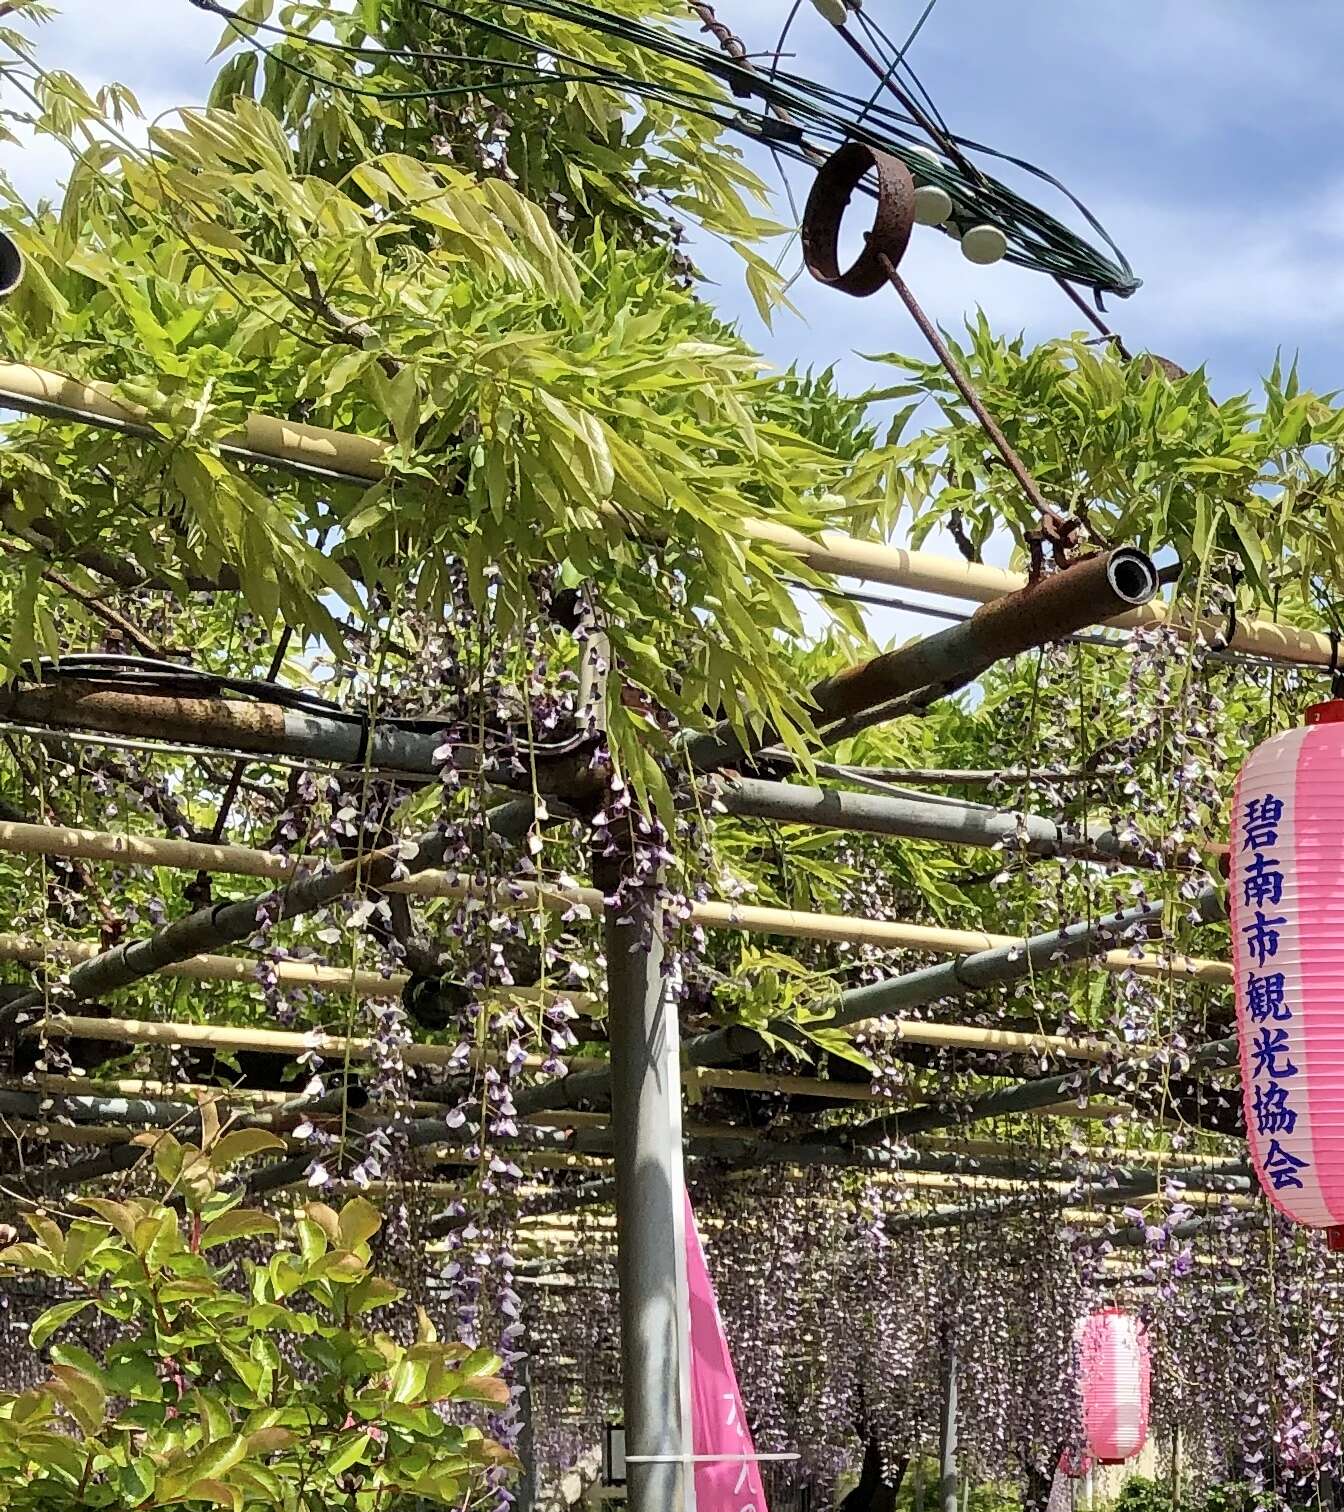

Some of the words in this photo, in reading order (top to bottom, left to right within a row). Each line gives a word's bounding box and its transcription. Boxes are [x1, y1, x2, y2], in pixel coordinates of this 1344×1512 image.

[1240, 793, 1312, 1190] 碧南市観光協会
